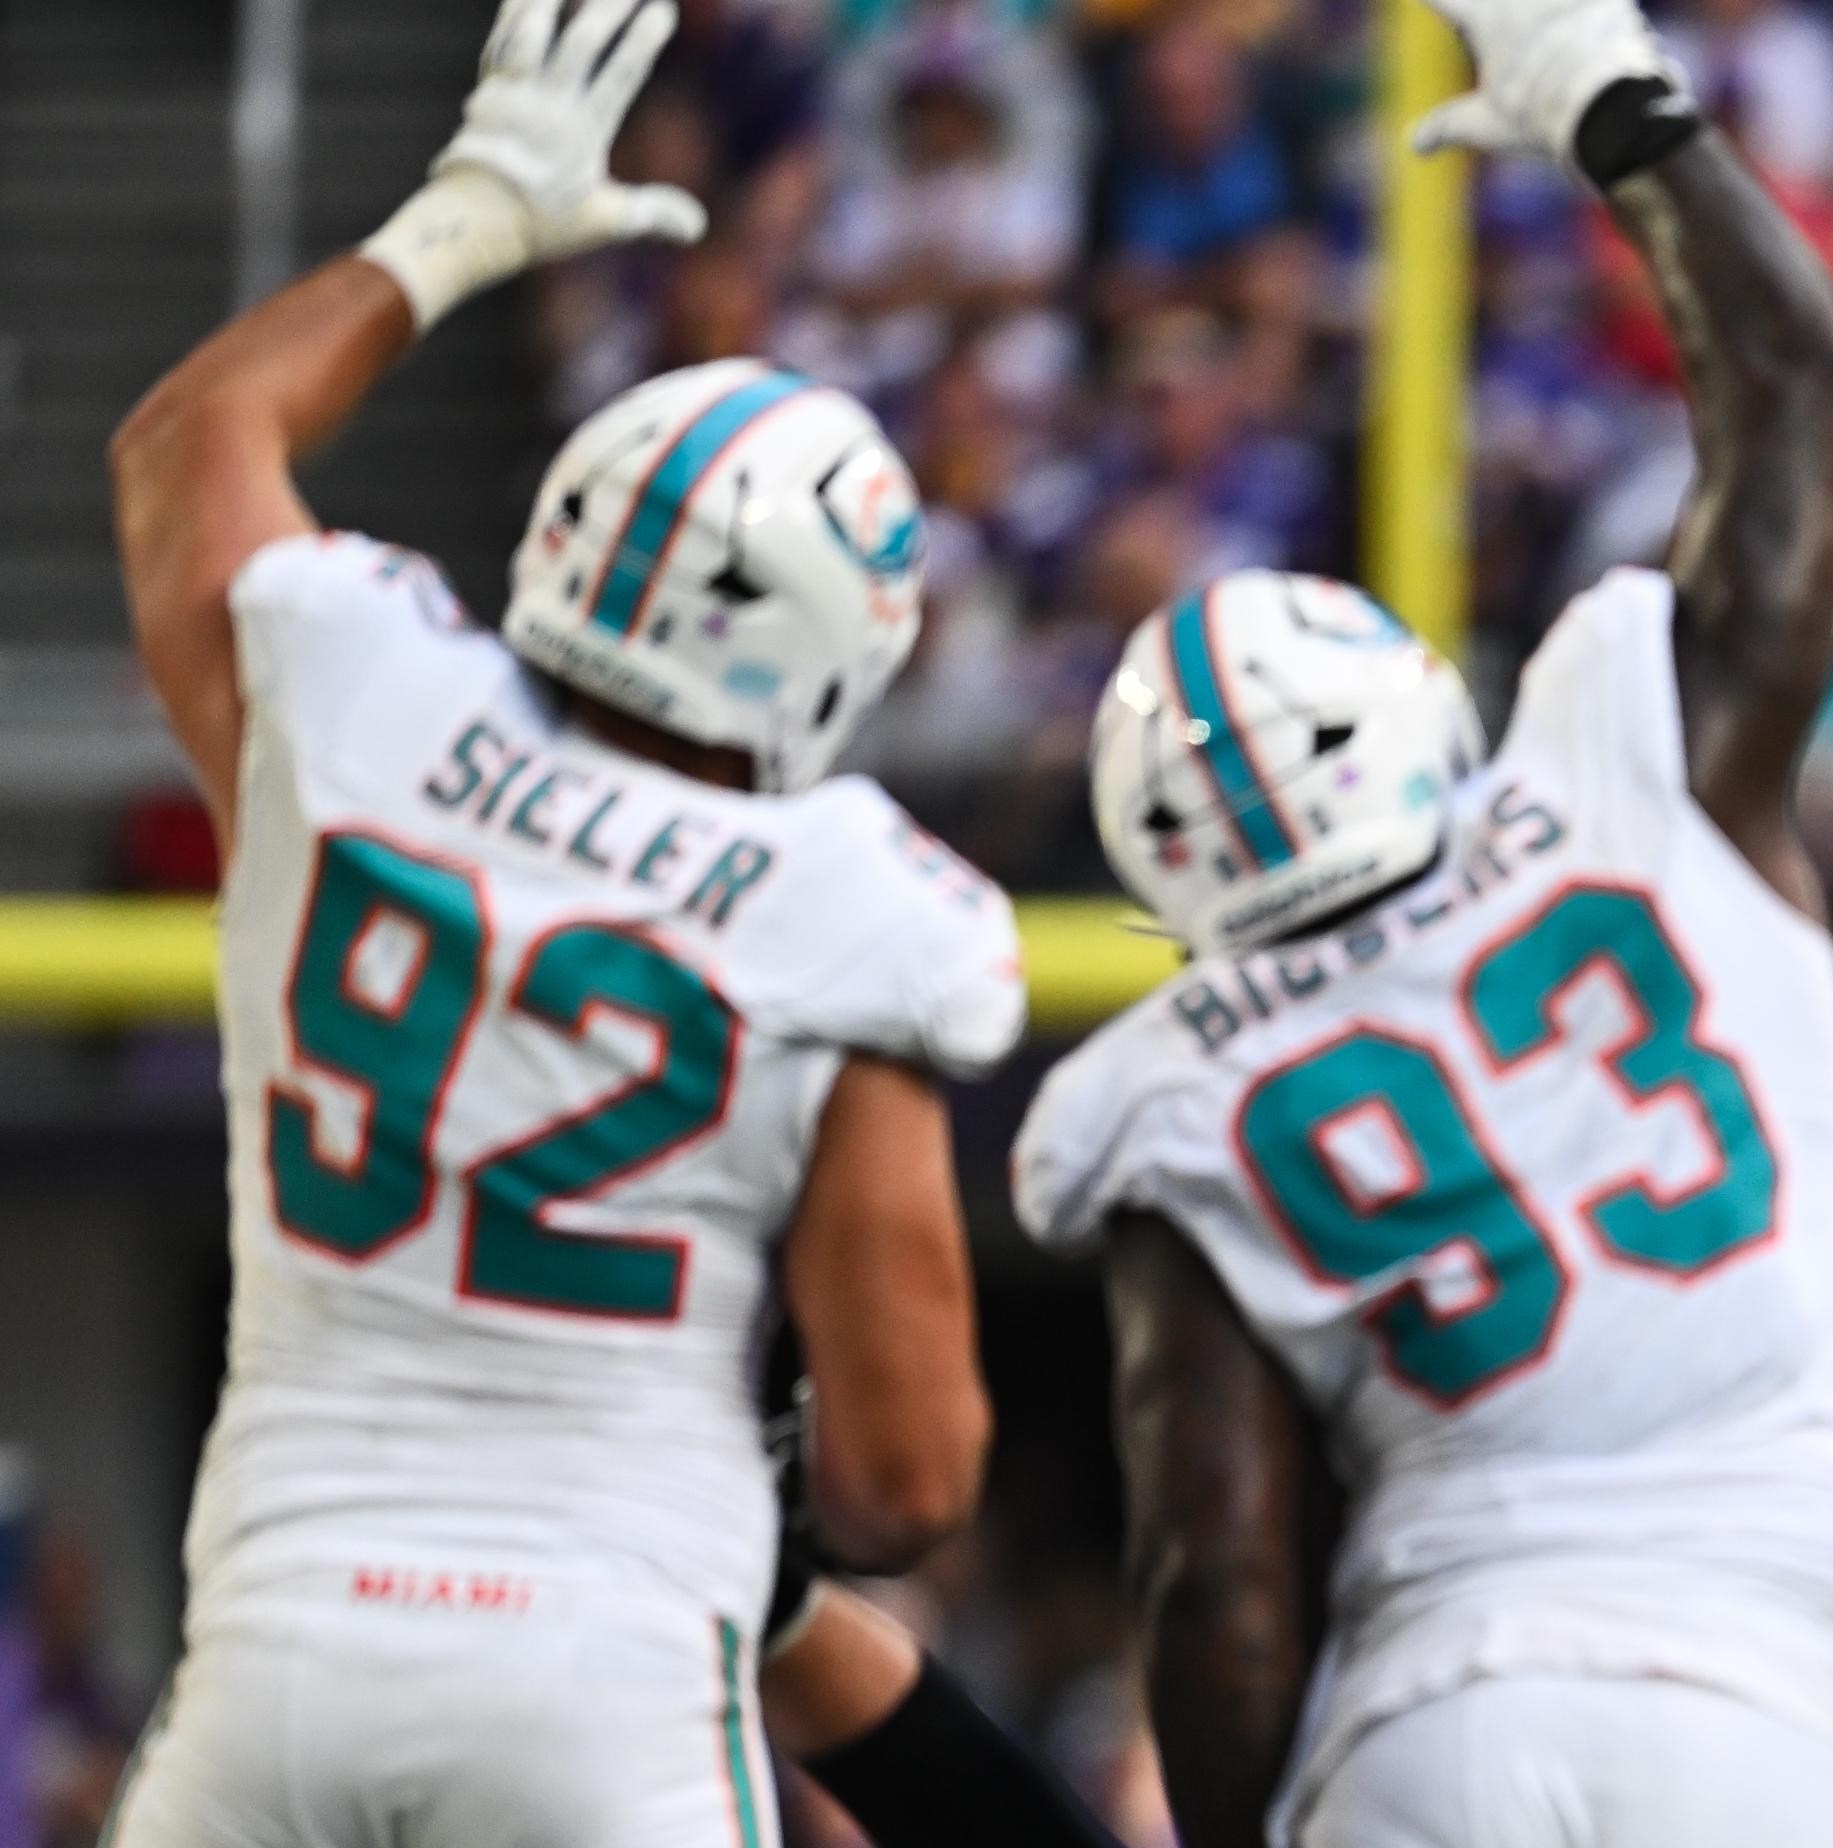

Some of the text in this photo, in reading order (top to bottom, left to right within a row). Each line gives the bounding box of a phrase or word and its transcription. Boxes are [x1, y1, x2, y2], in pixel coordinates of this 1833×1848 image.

[423, 720, 776, 933] SIELER
[266, 828, 744, 1326] 92
[1234, 874, 1782, 1412] 93
[350, 1560, 536, 1618] MIAMI
